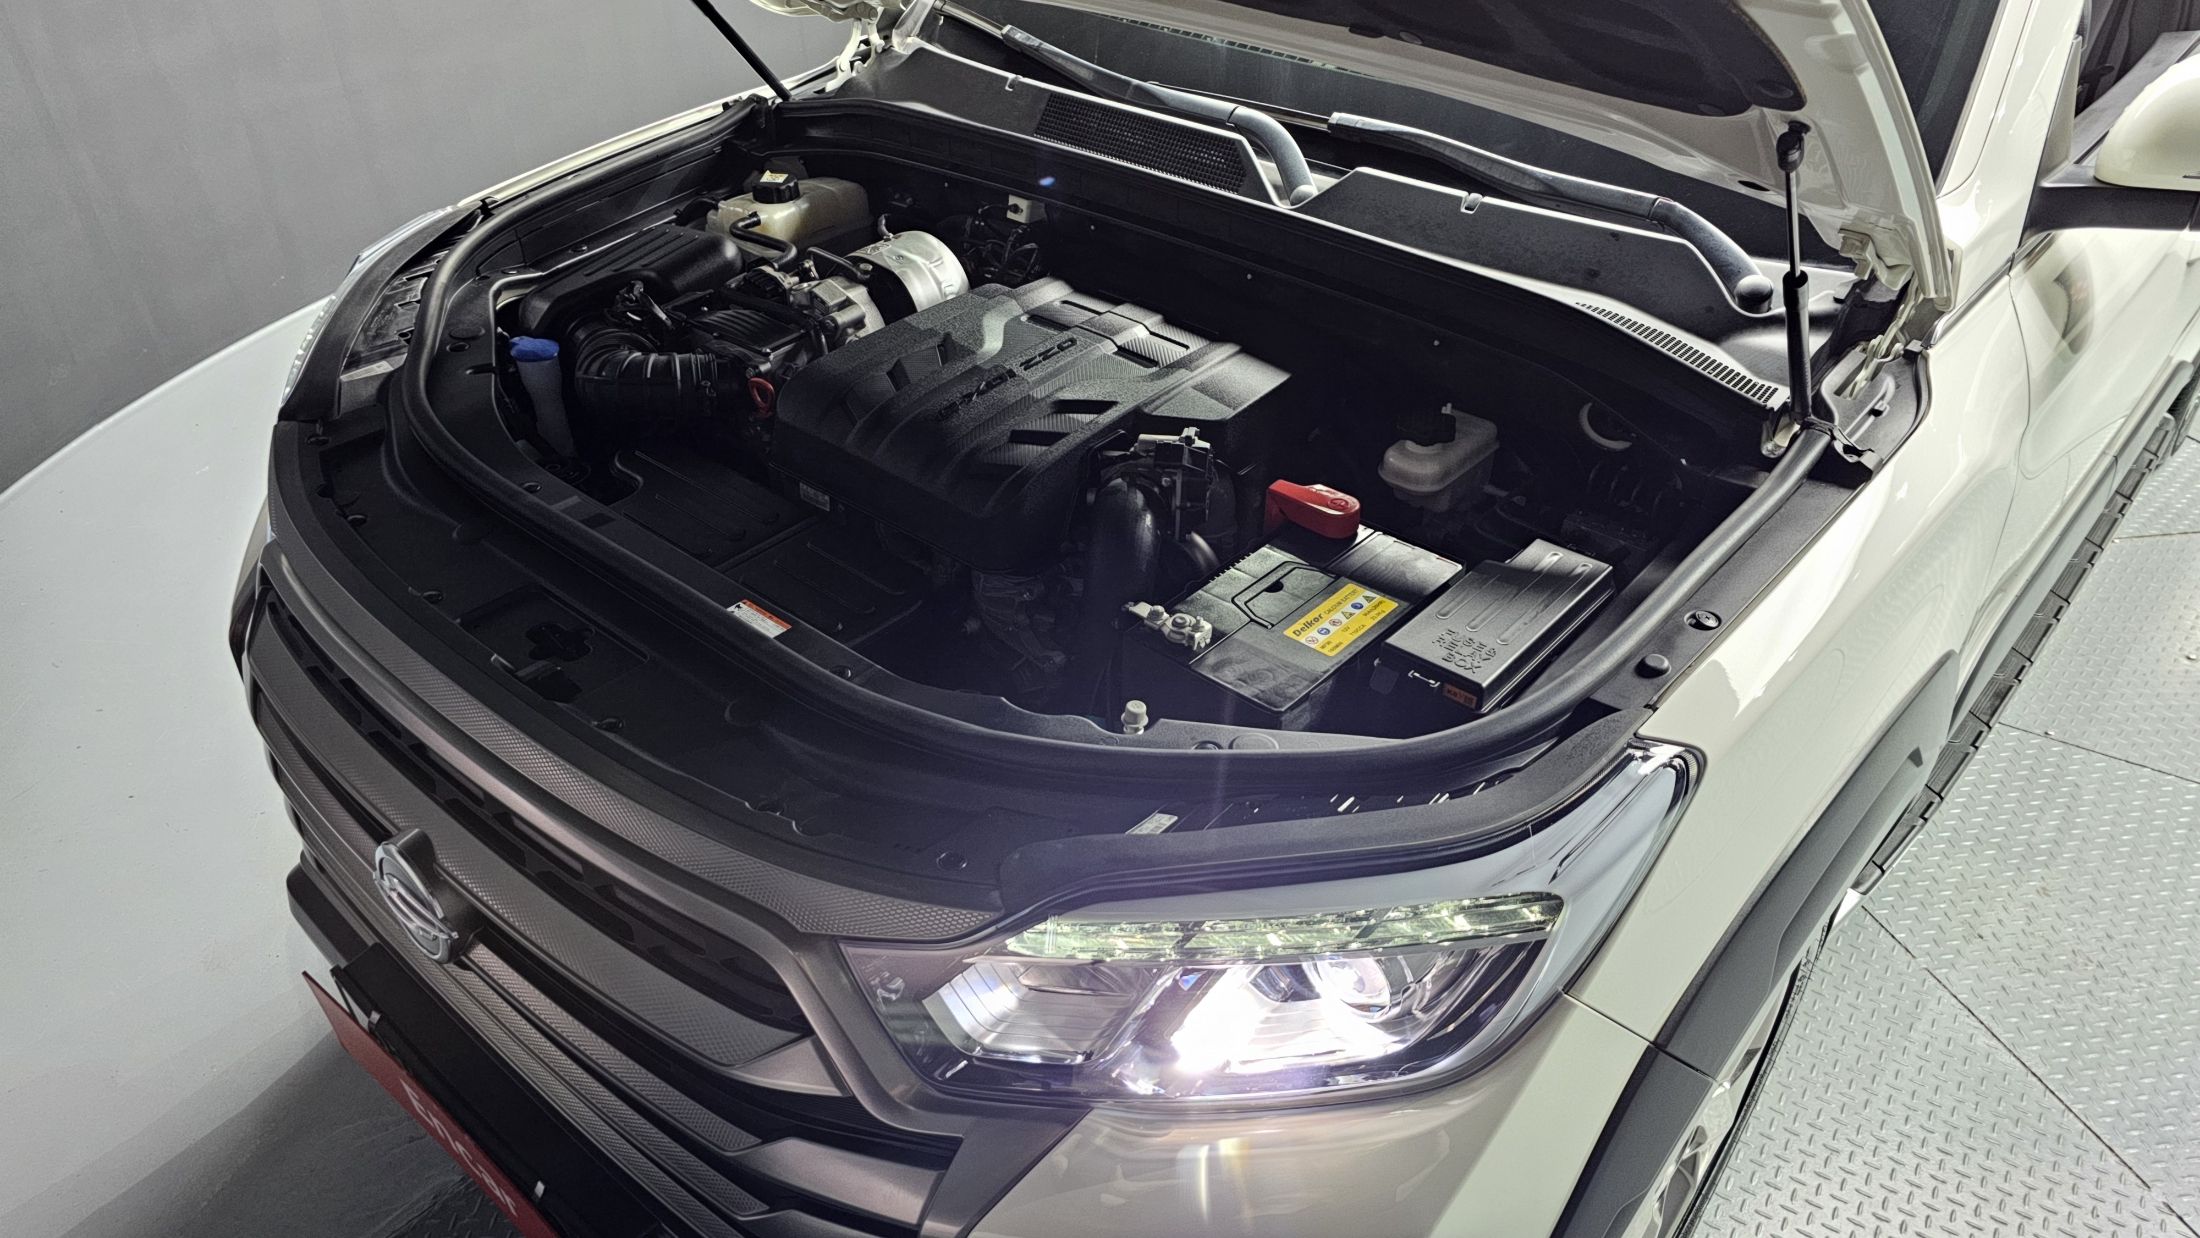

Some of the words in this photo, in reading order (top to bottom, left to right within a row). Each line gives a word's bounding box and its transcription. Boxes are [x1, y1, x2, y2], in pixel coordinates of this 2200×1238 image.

[1019, 337, 1078, 371] 220
[1292, 612, 1324, 637] Delkor
[1441, 652, 1481, 673] BOX
[400, 1078, 518, 1218] Encar
